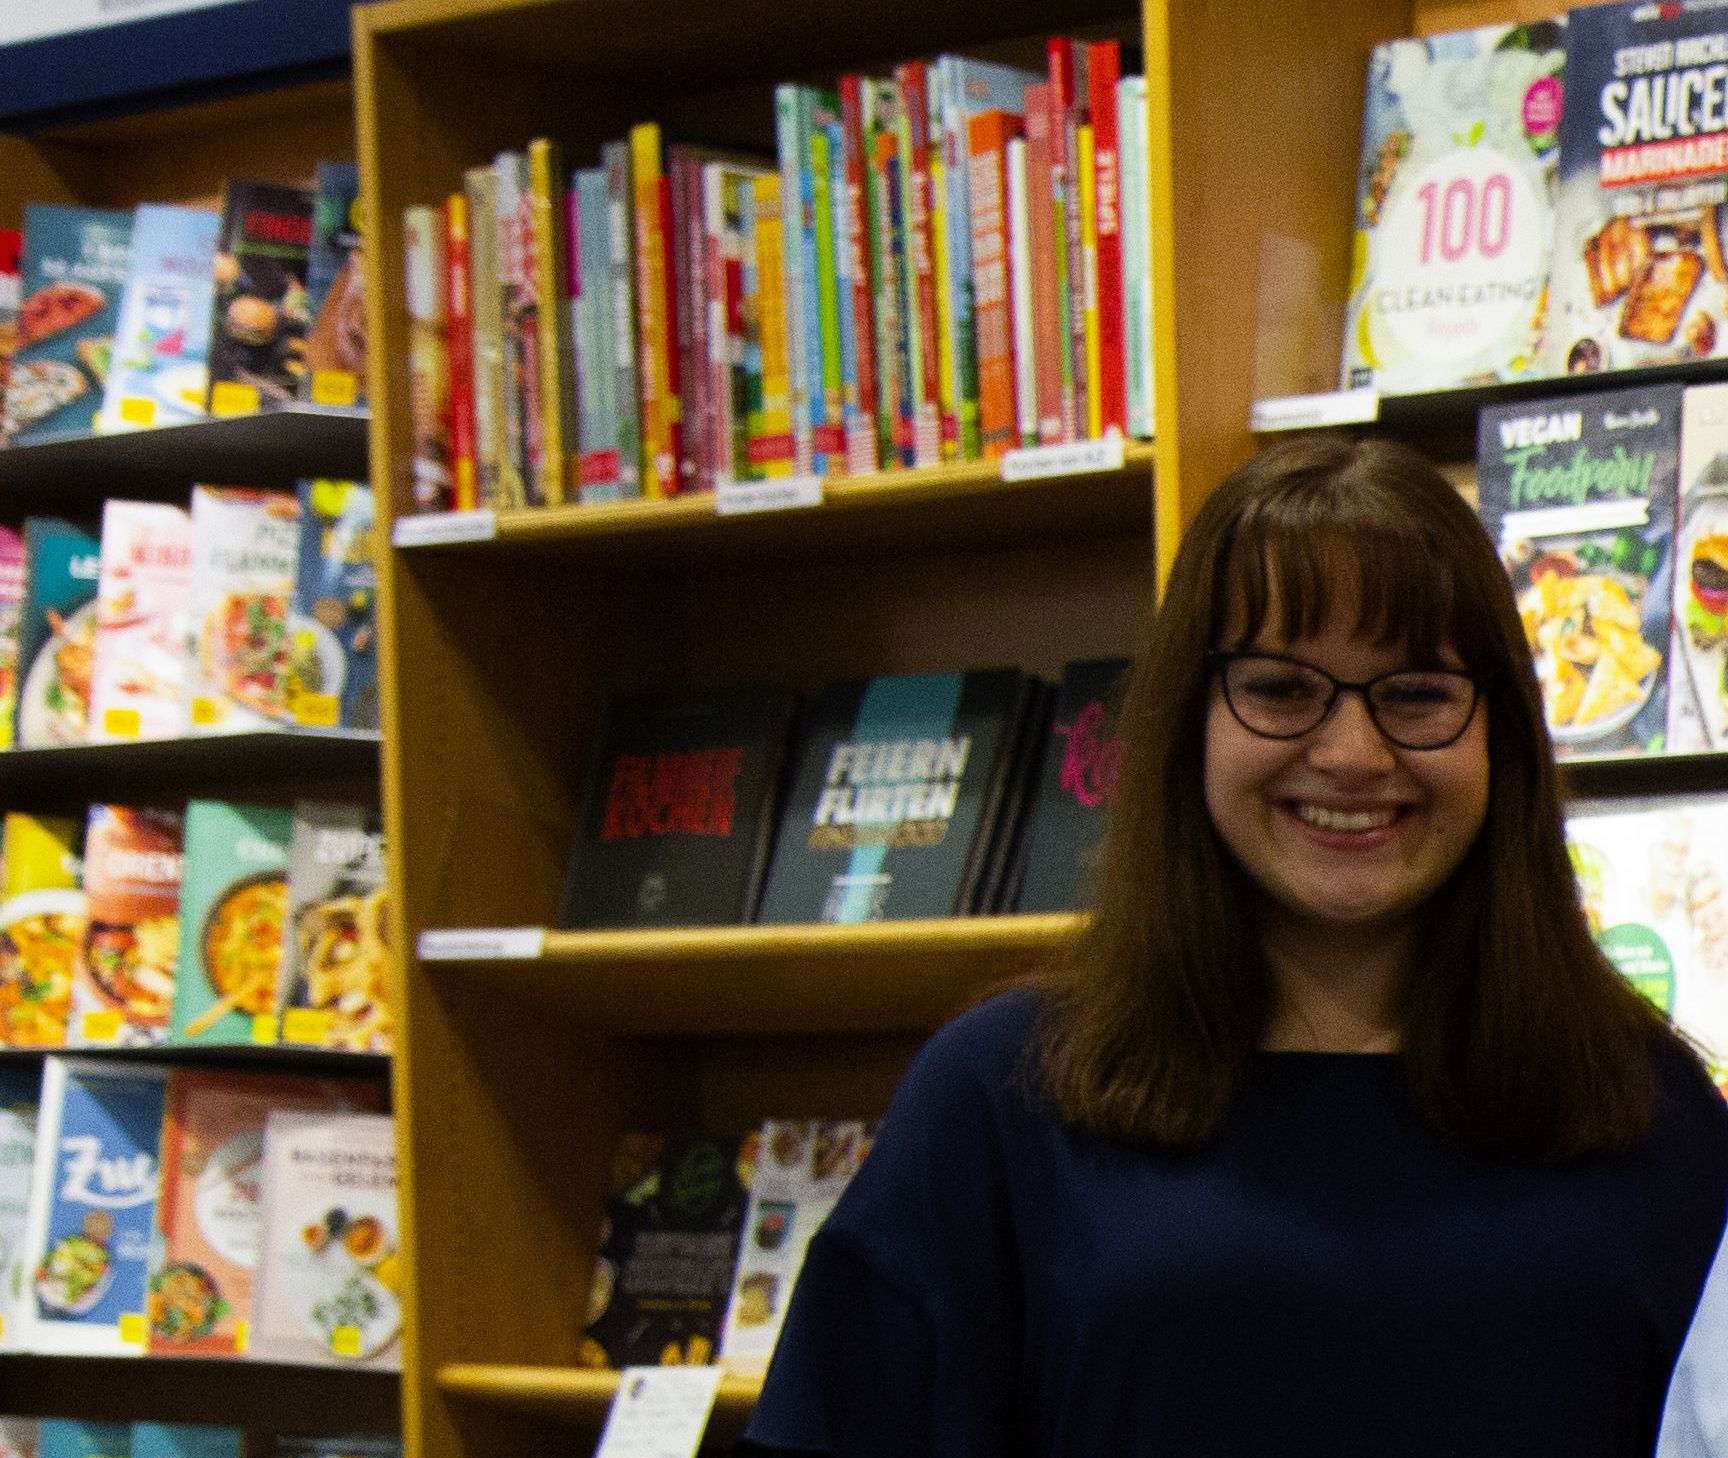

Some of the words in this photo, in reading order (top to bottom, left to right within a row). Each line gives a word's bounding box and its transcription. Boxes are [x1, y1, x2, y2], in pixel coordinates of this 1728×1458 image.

[1416, 172, 1513, 266] 100
[1498, 410, 1583, 450] VEGAN
[829, 738, 972, 784] FEIERN
[814, 782, 959, 826] FLIRTEN
